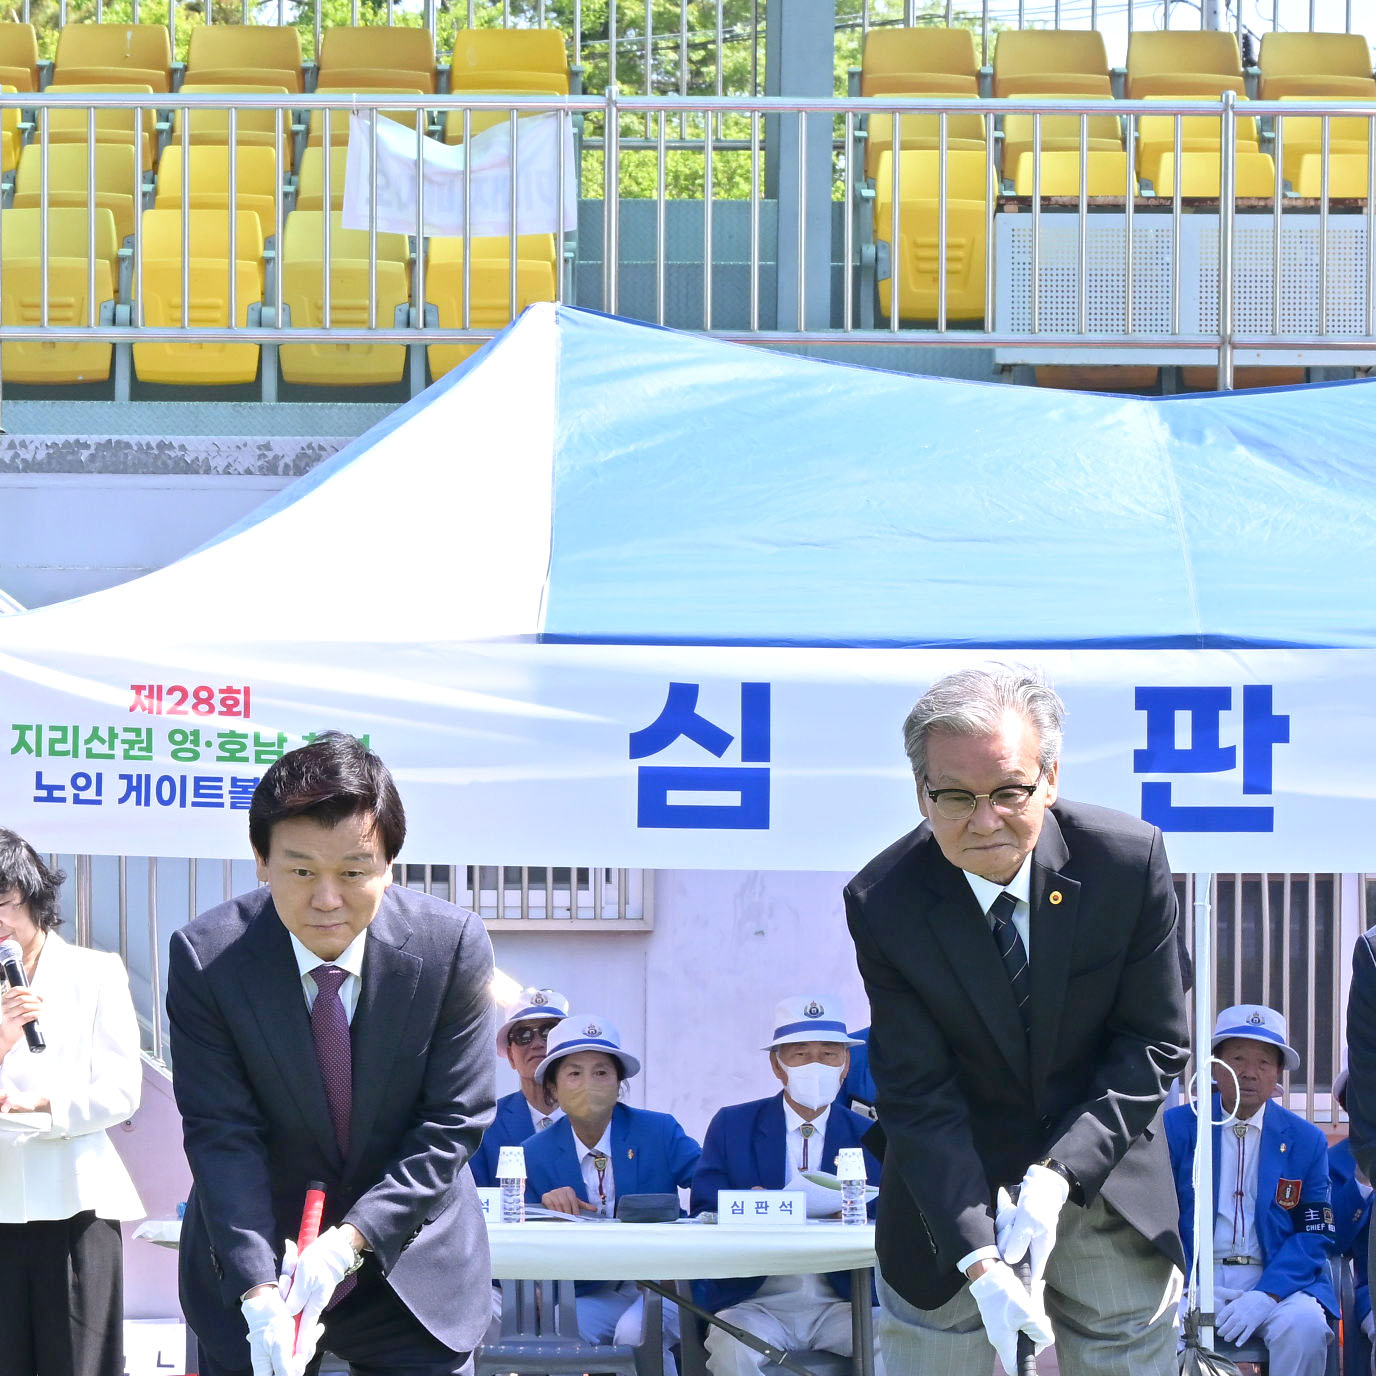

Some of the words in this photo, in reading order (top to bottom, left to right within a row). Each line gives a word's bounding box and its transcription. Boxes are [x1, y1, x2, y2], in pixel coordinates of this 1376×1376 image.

[129, 684, 251, 719] 제28회
[10, 723, 154, 762] 지리산권
[167, 728, 289, 765] 영·호남
[33, 771, 103, 806] 노인
[117, 773, 262, 810] 게이트볼
[1305, 1223, 1326, 1232] CHIEF
